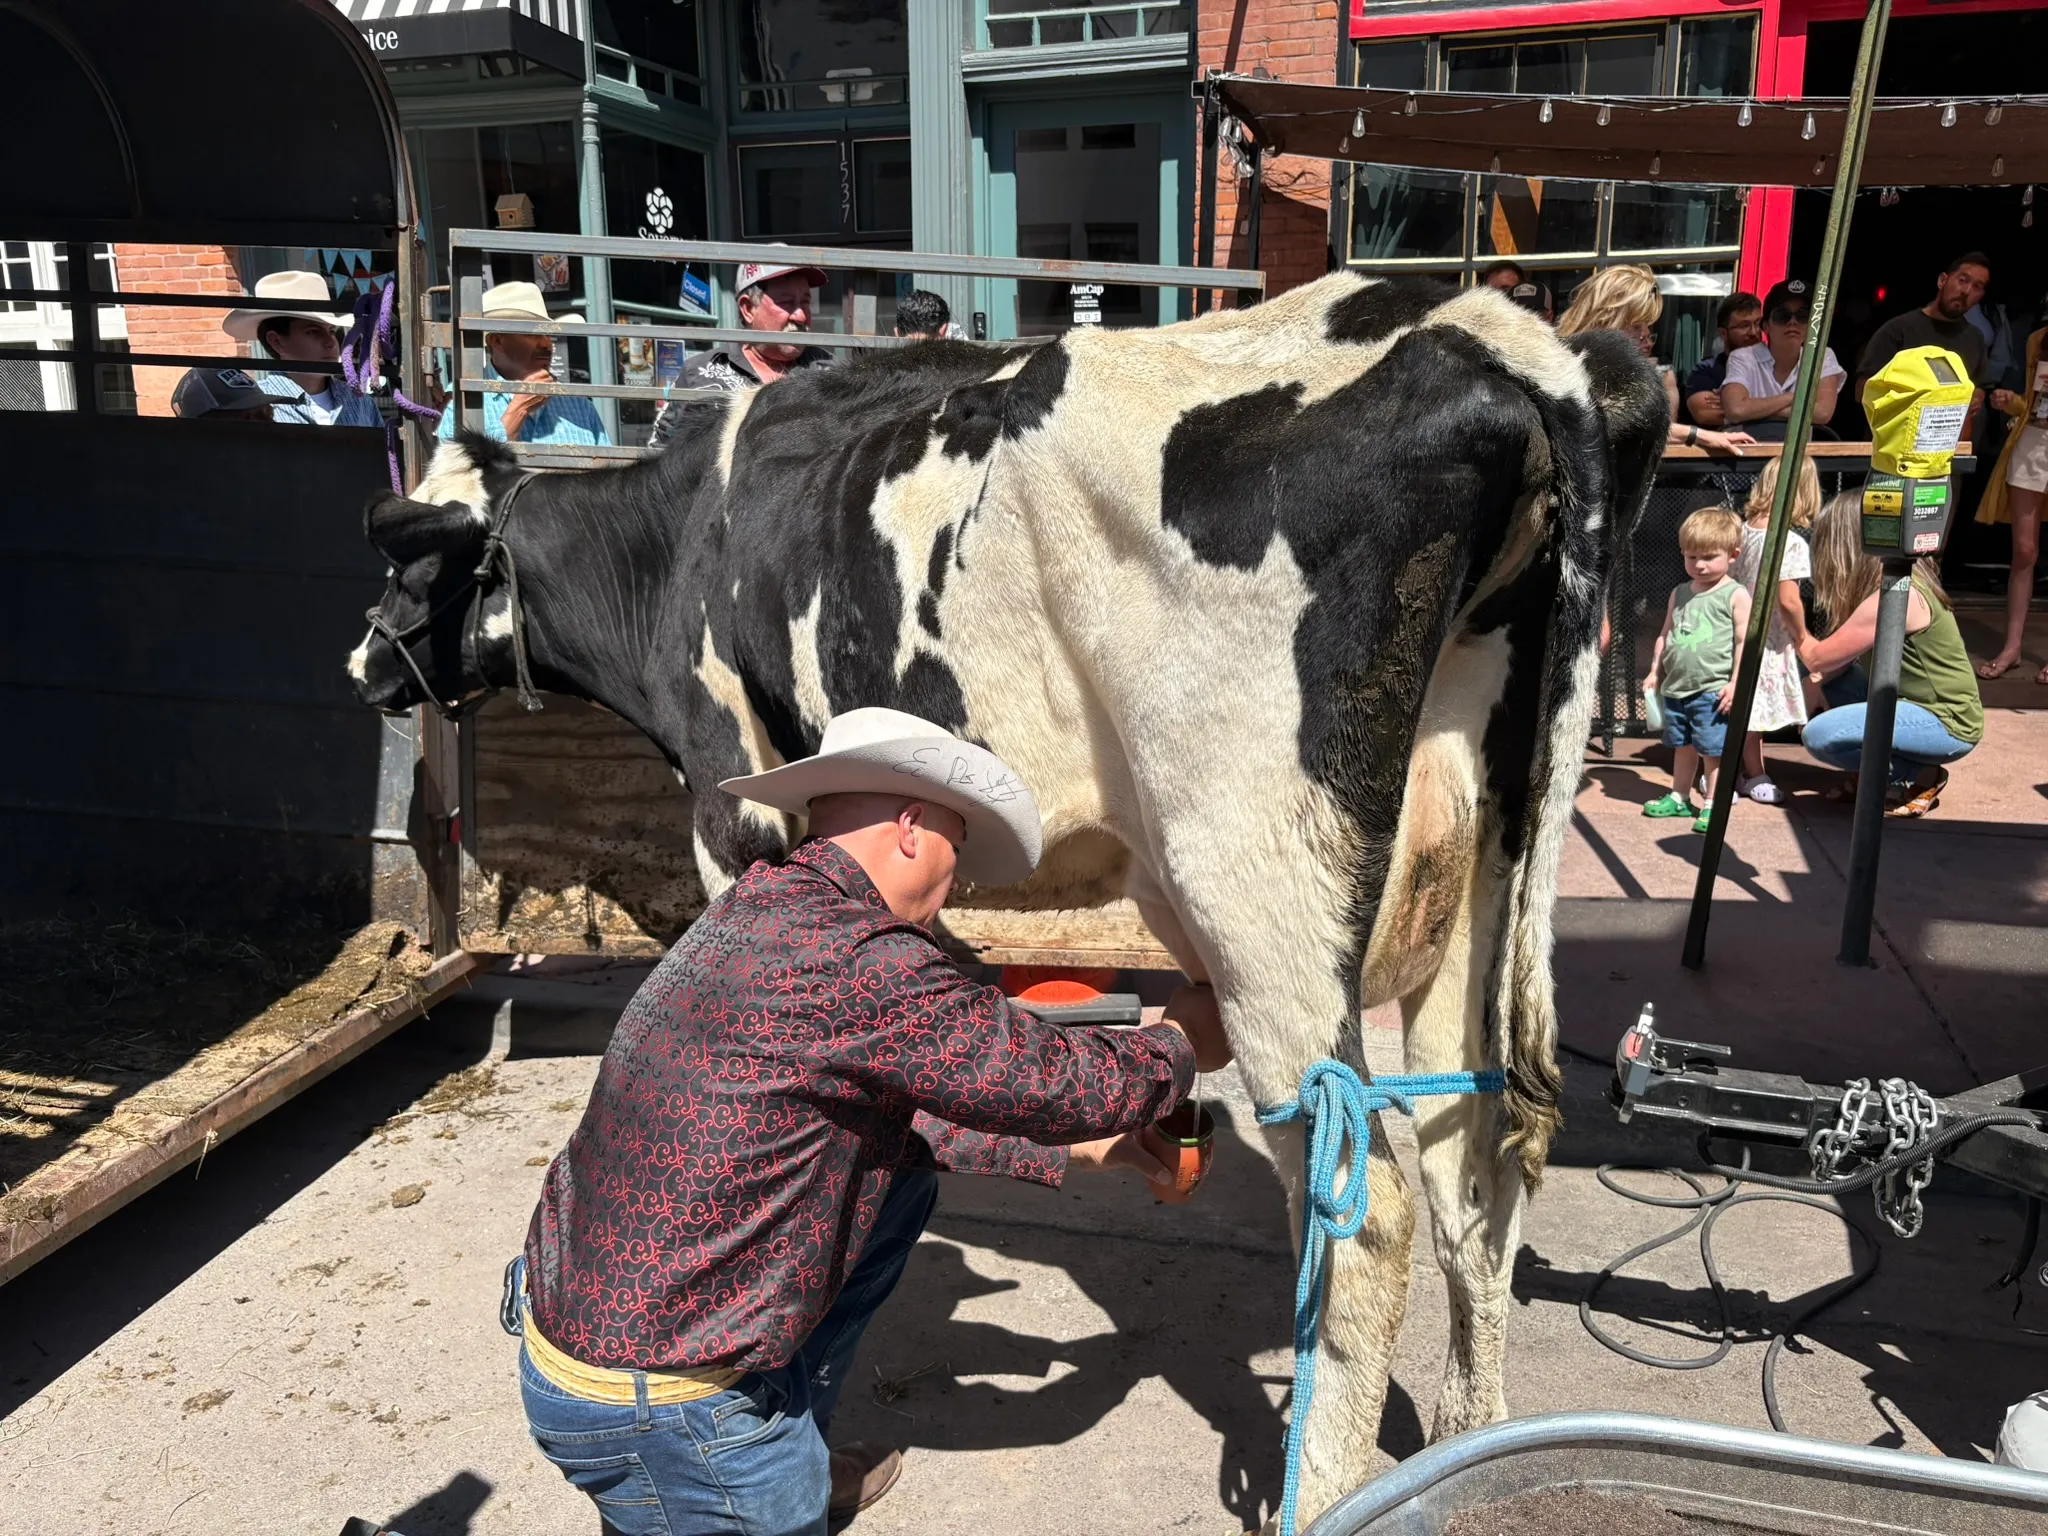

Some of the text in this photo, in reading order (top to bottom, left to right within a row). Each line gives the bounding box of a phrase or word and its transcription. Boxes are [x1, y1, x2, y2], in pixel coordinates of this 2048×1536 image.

[840, 141, 850, 224] 1537
[683, 279, 708, 300] Closed
[1070, 283, 1105, 296] AmCap
